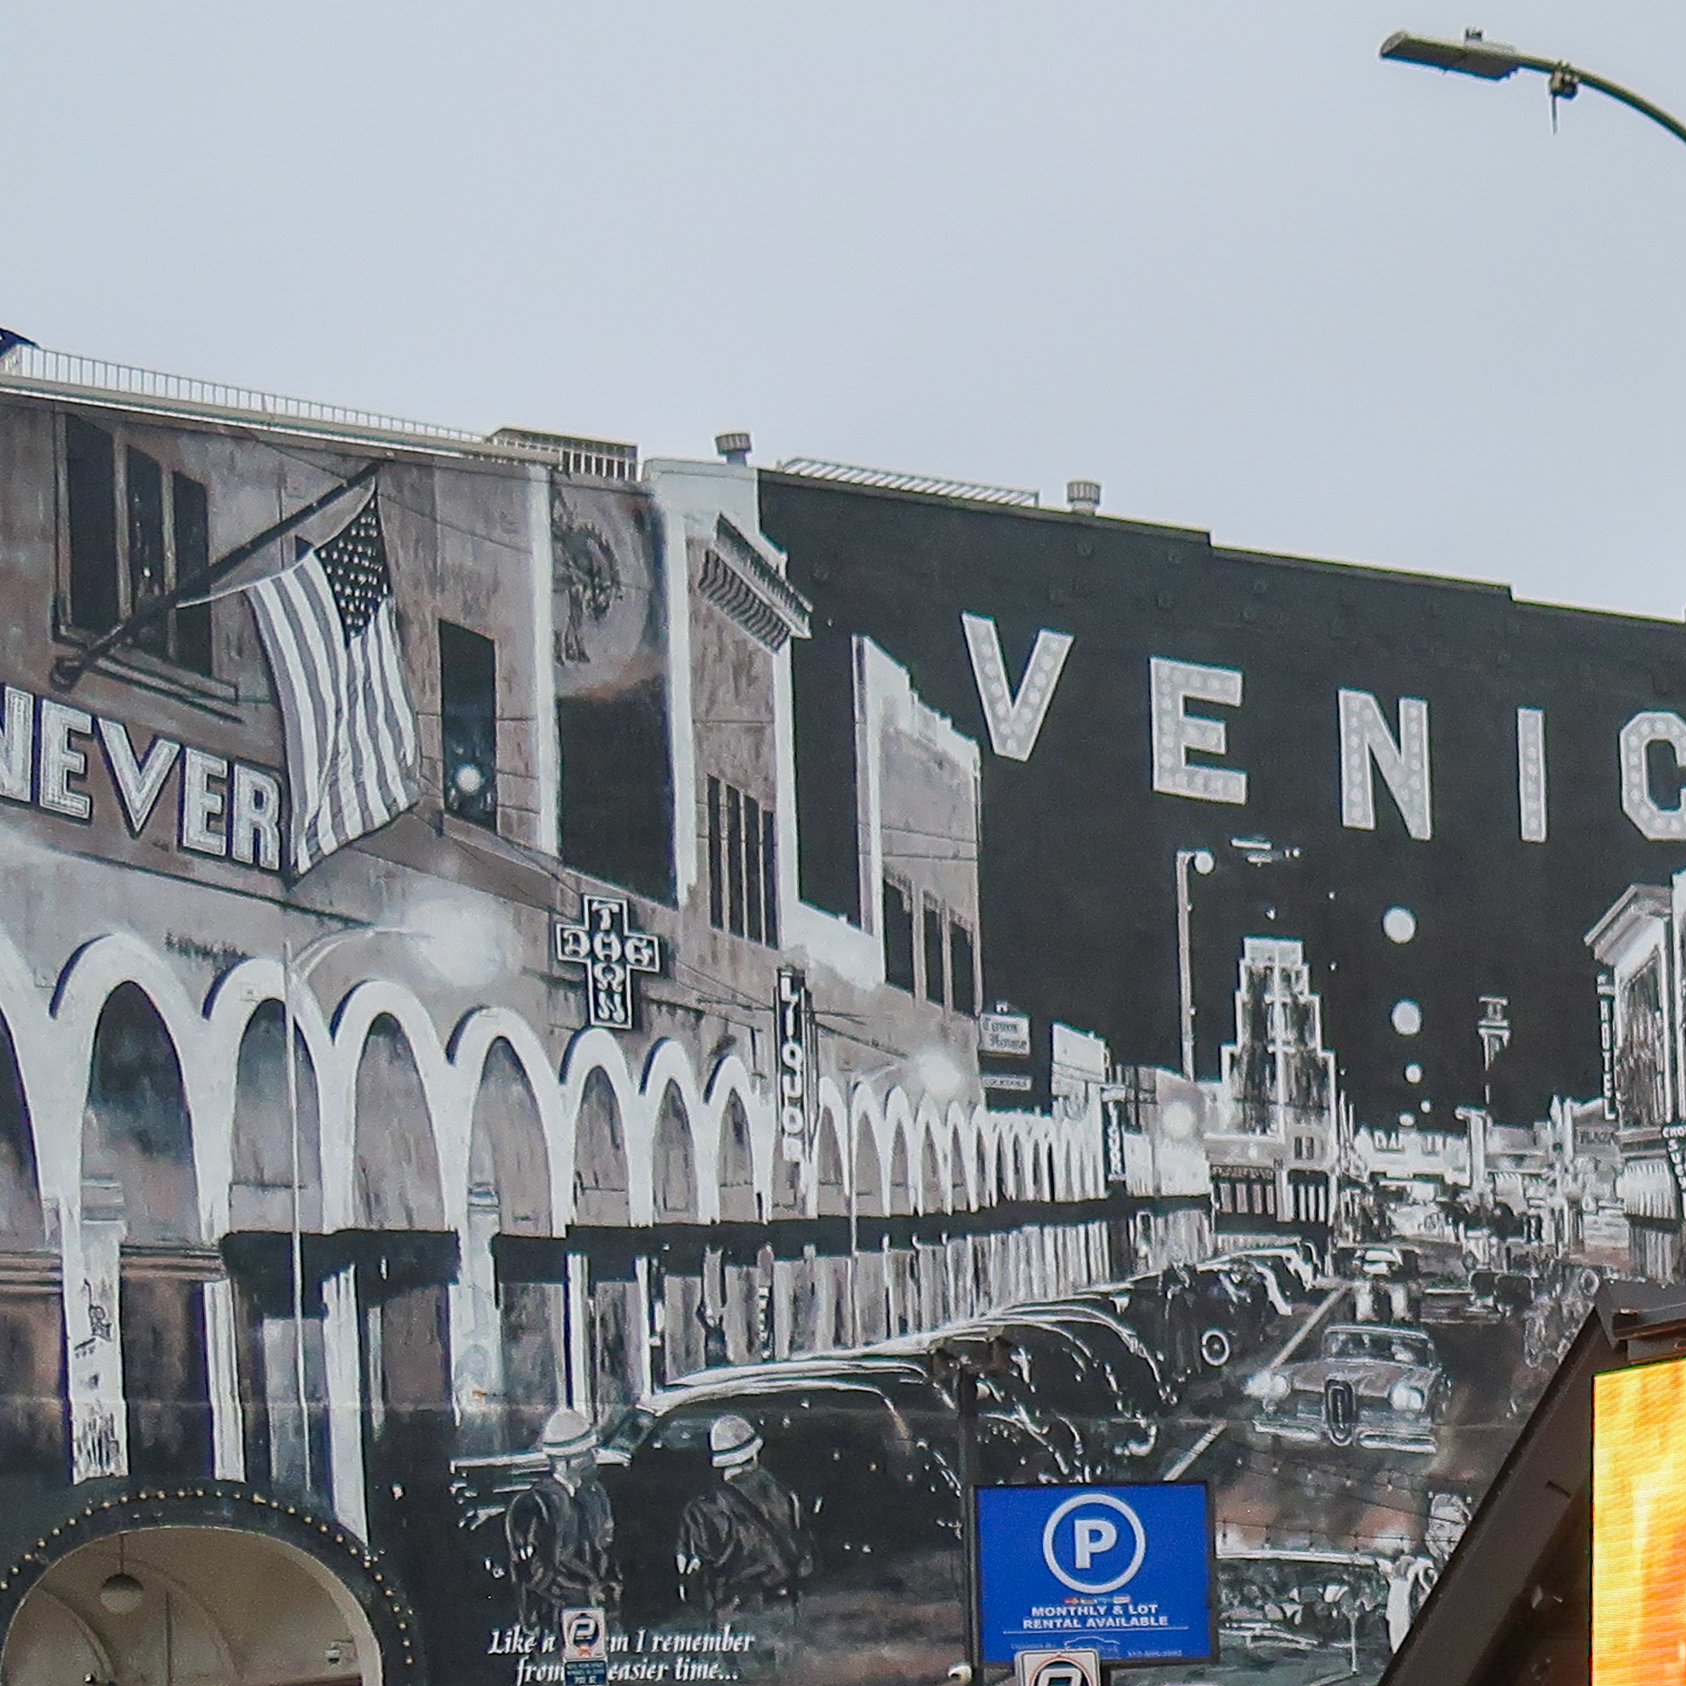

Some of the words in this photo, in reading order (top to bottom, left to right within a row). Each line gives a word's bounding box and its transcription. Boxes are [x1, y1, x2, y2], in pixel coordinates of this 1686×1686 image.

[1073, 1518, 1118, 1570] P
[1022, 1617, 1082, 1630] RENTAL
[1086, 1616, 1168, 1628] AVAILABLE
[1031, 1605, 1107, 1617] MONTHLY
[1112, 1605, 1124, 1616] &
[1128, 1604, 1159, 1615] LOT
[488, 1624, 538, 1655] Like
[541, 1637, 555, 1654] a
[636, 1629, 645, 1653] I
[652, 1624, 755, 1654] remember
[607, 1657, 669, 1683] easier
[675, 1656, 739, 1683] time...
